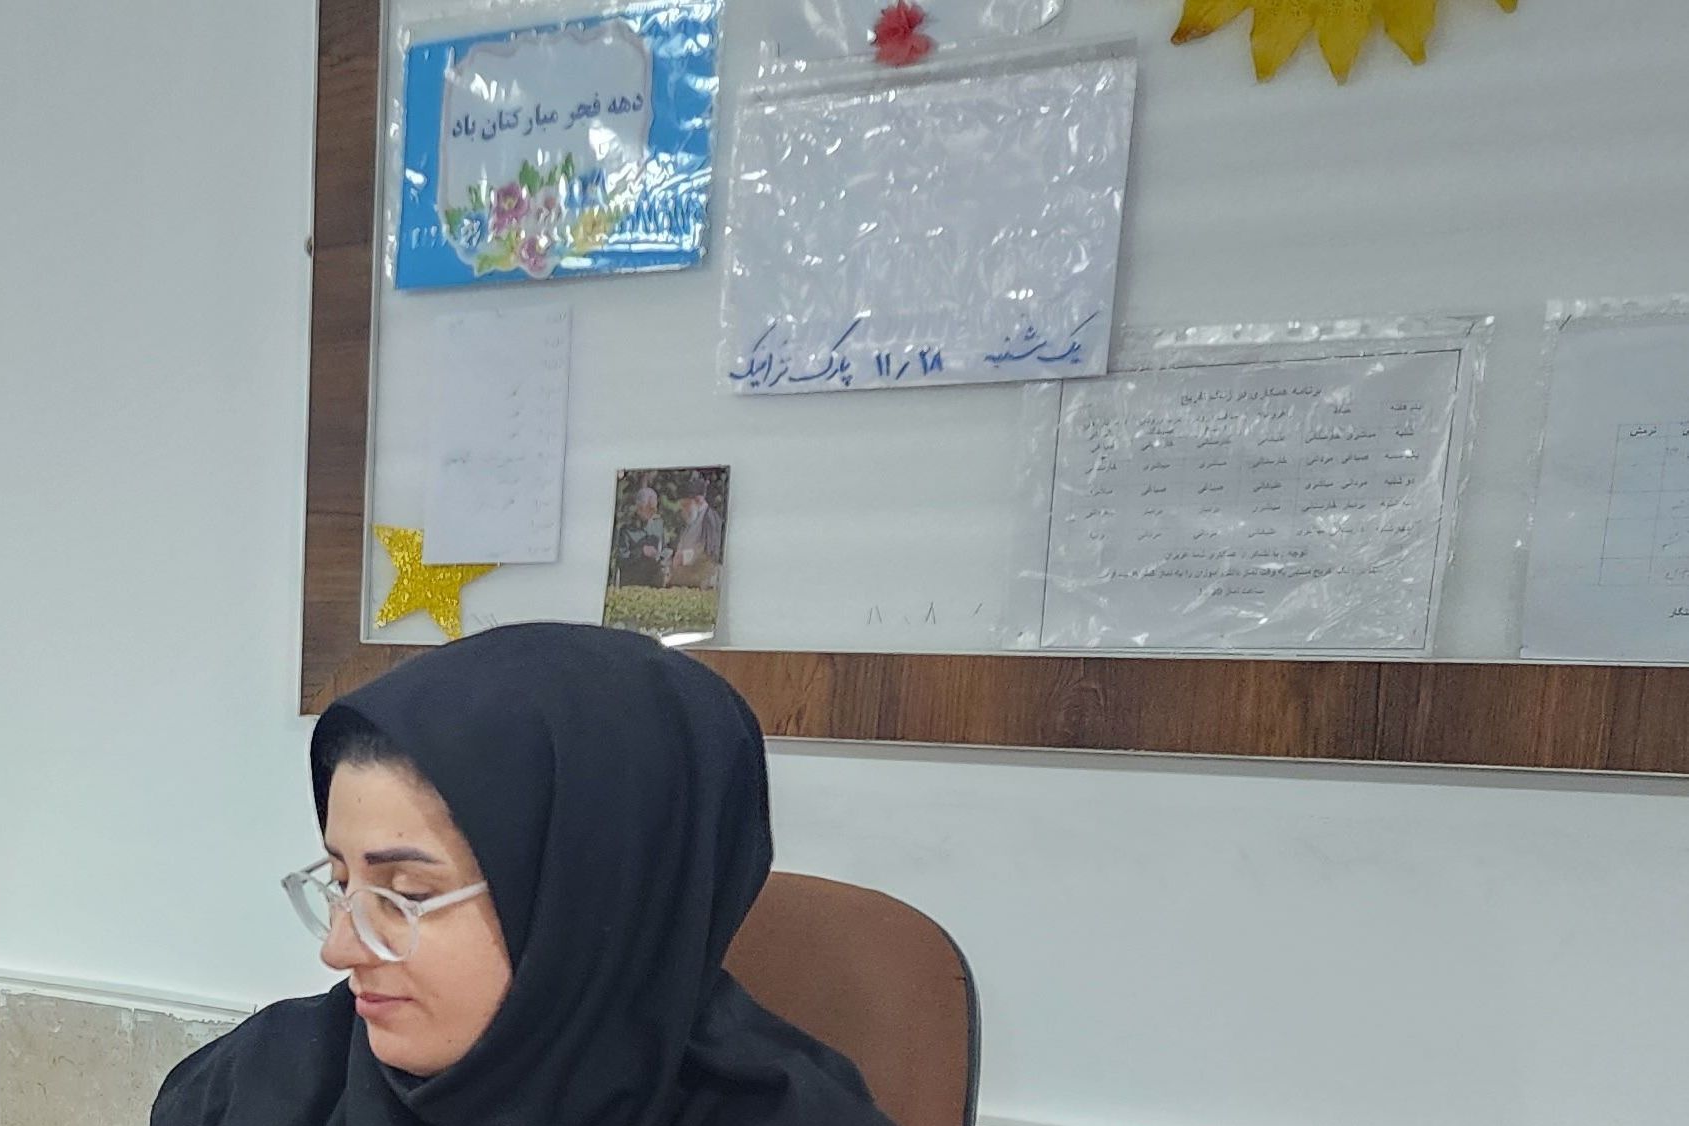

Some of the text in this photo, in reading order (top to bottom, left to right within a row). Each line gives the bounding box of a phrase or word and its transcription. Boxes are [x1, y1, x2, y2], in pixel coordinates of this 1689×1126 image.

[564, 92, 601, 130] فجر
[607, 92, 644, 116] دهه
[452, 112, 476, 142] باد
